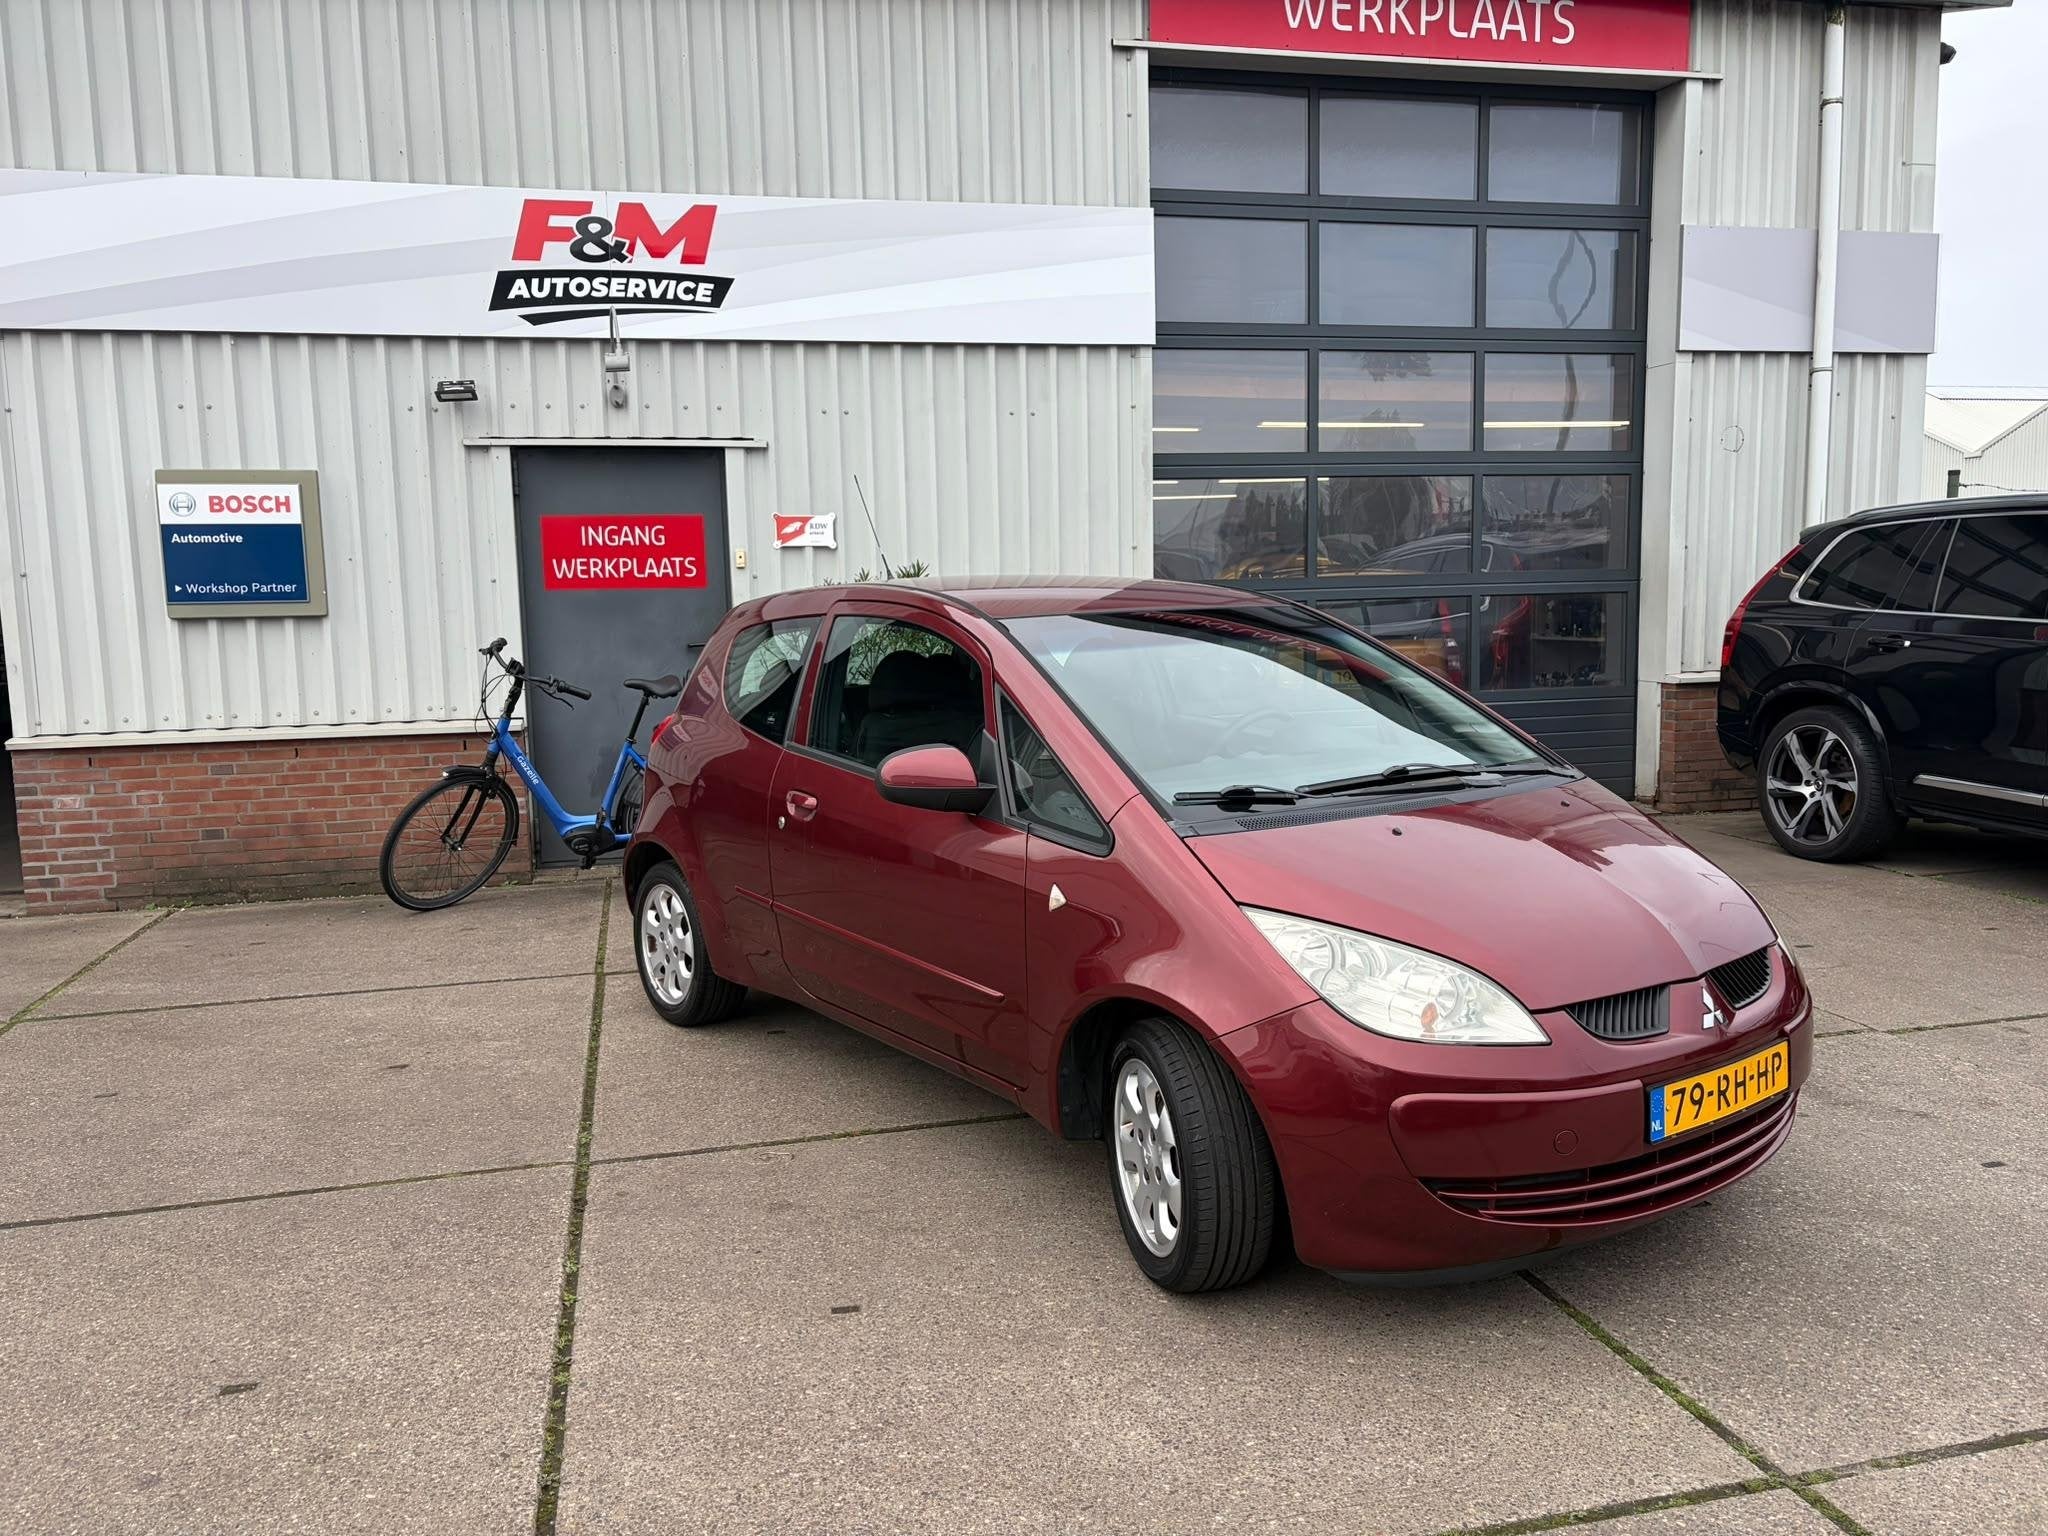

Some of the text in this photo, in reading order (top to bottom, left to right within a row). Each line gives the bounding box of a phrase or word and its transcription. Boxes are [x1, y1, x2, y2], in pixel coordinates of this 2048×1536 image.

[1284, 0, 1576, 45] WERKPLAATS
[511, 198, 718, 265] F&M
[507, 276, 715, 303] AUTOSERVICE
[208, 494, 292, 514] BOSCH
[171, 532, 244, 544] Automotive
[580, 525, 666, 546] INGANG
[552, 556, 698, 579] WERKPLAATS
[185, 582, 297, 595] Workshop Partner
[1671, 1050, 1783, 1128] 79-RH-HP
[1650, 1119, 1664, 1133] NL
